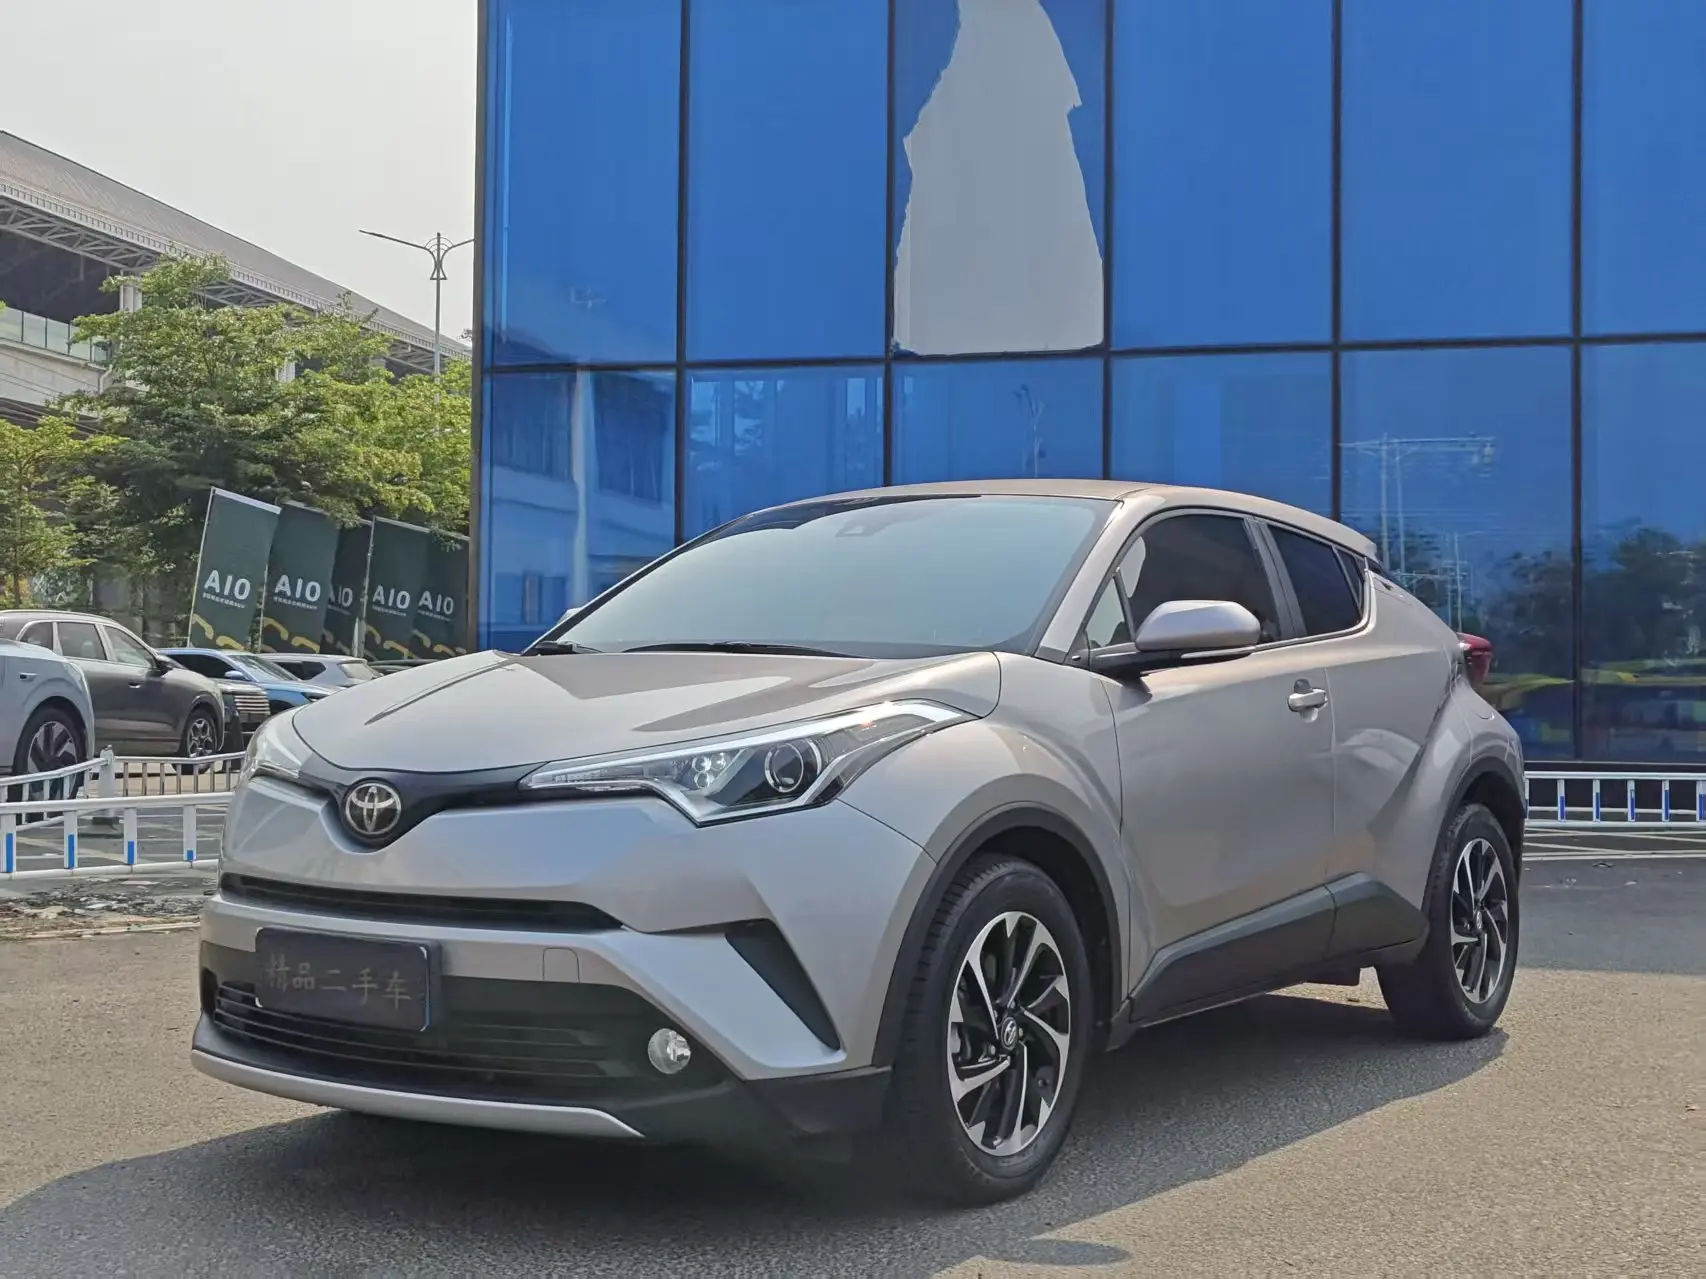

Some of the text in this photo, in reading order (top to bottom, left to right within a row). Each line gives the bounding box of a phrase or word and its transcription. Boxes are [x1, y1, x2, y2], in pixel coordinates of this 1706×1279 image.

[264, 952, 412, 1010] 精品二手车
